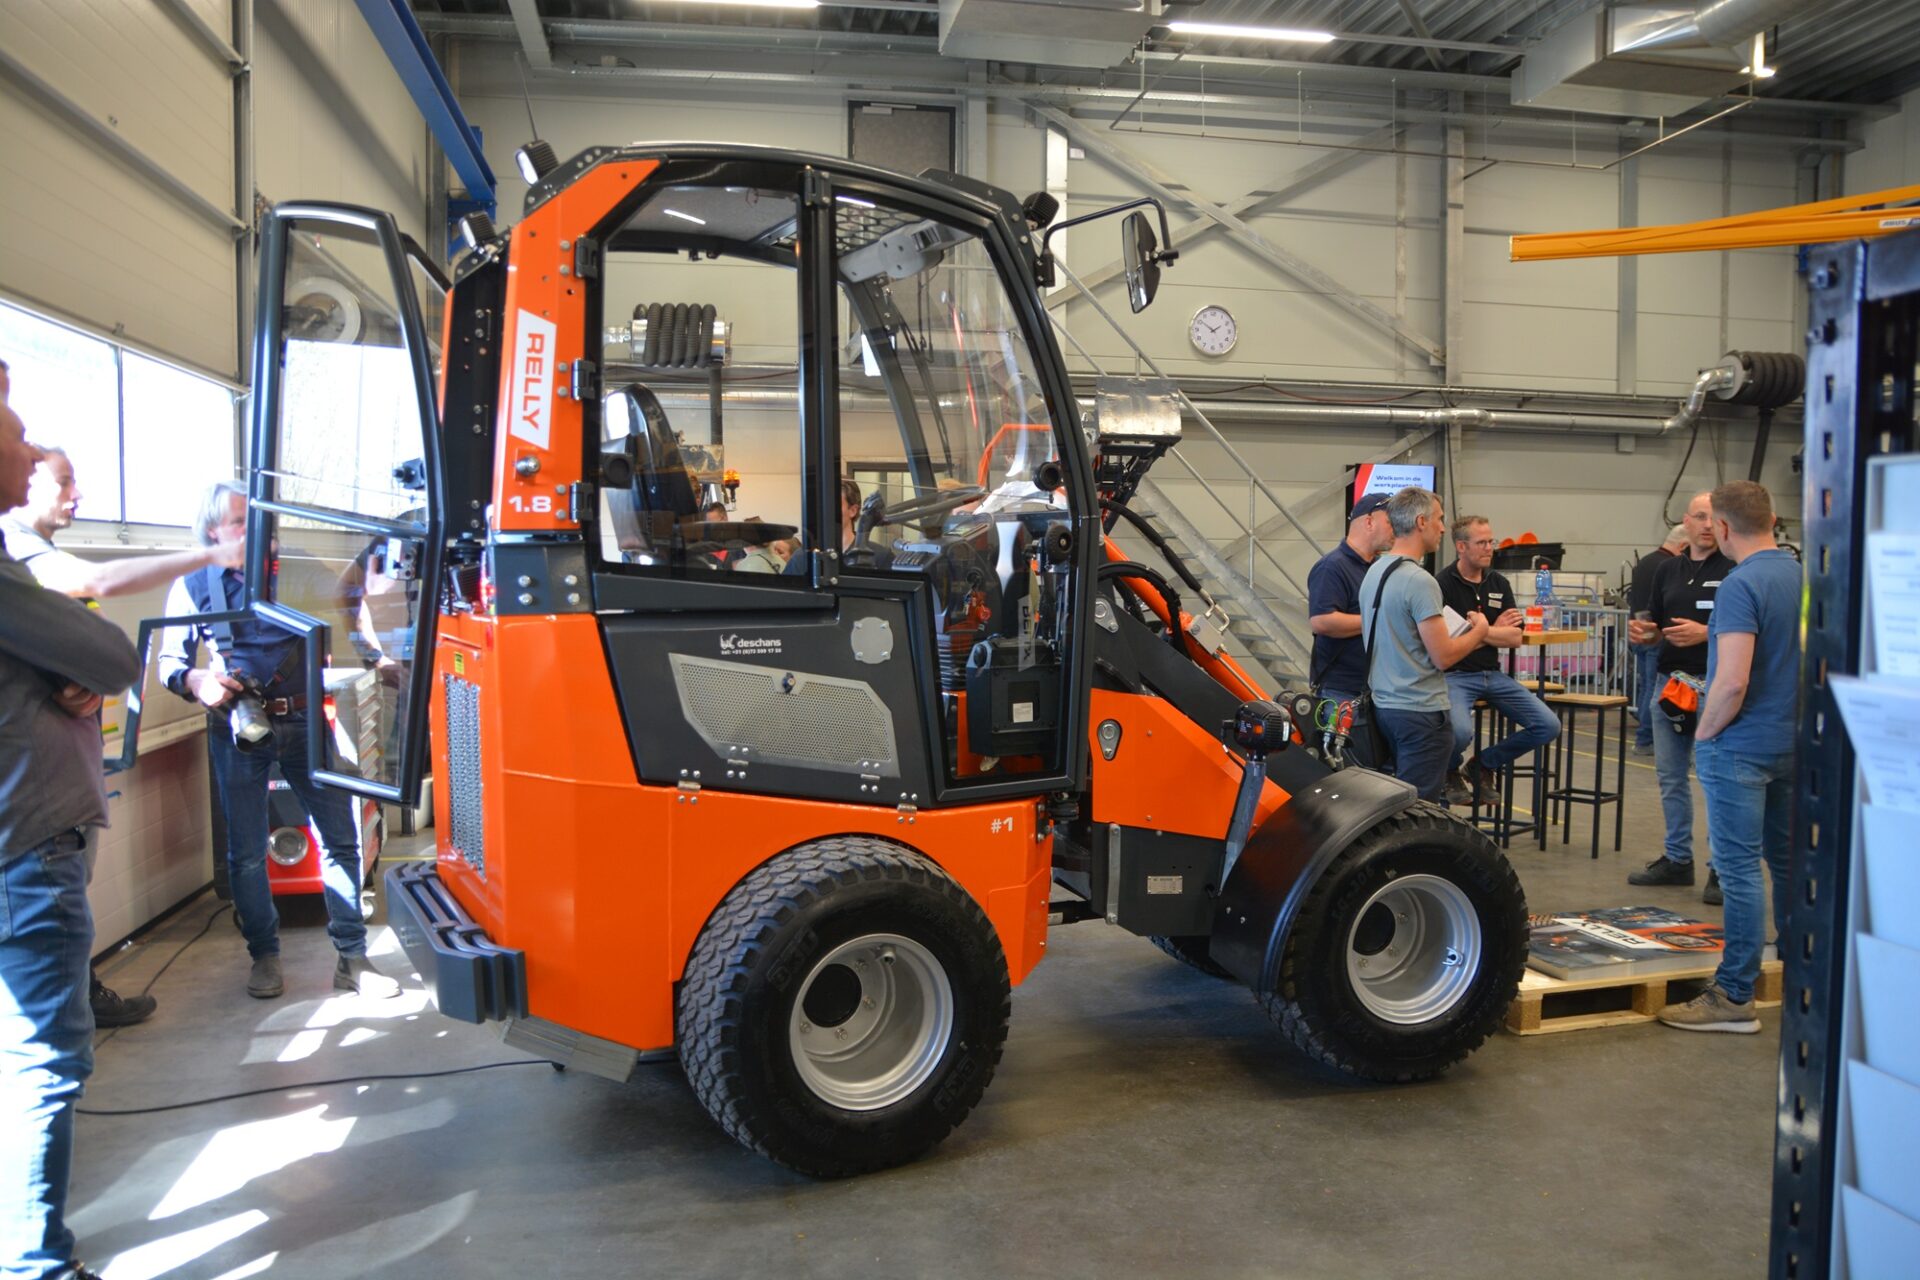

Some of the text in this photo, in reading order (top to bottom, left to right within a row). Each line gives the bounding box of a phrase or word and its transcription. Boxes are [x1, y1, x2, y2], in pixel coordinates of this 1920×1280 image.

[522, 332, 545, 430] RELLY
[508, 496, 552, 513] 1.8
[738, 638, 782, 648] deschans
[990, 817, 1014, 834] #1
[1576, 921, 1642, 945] RELLY
